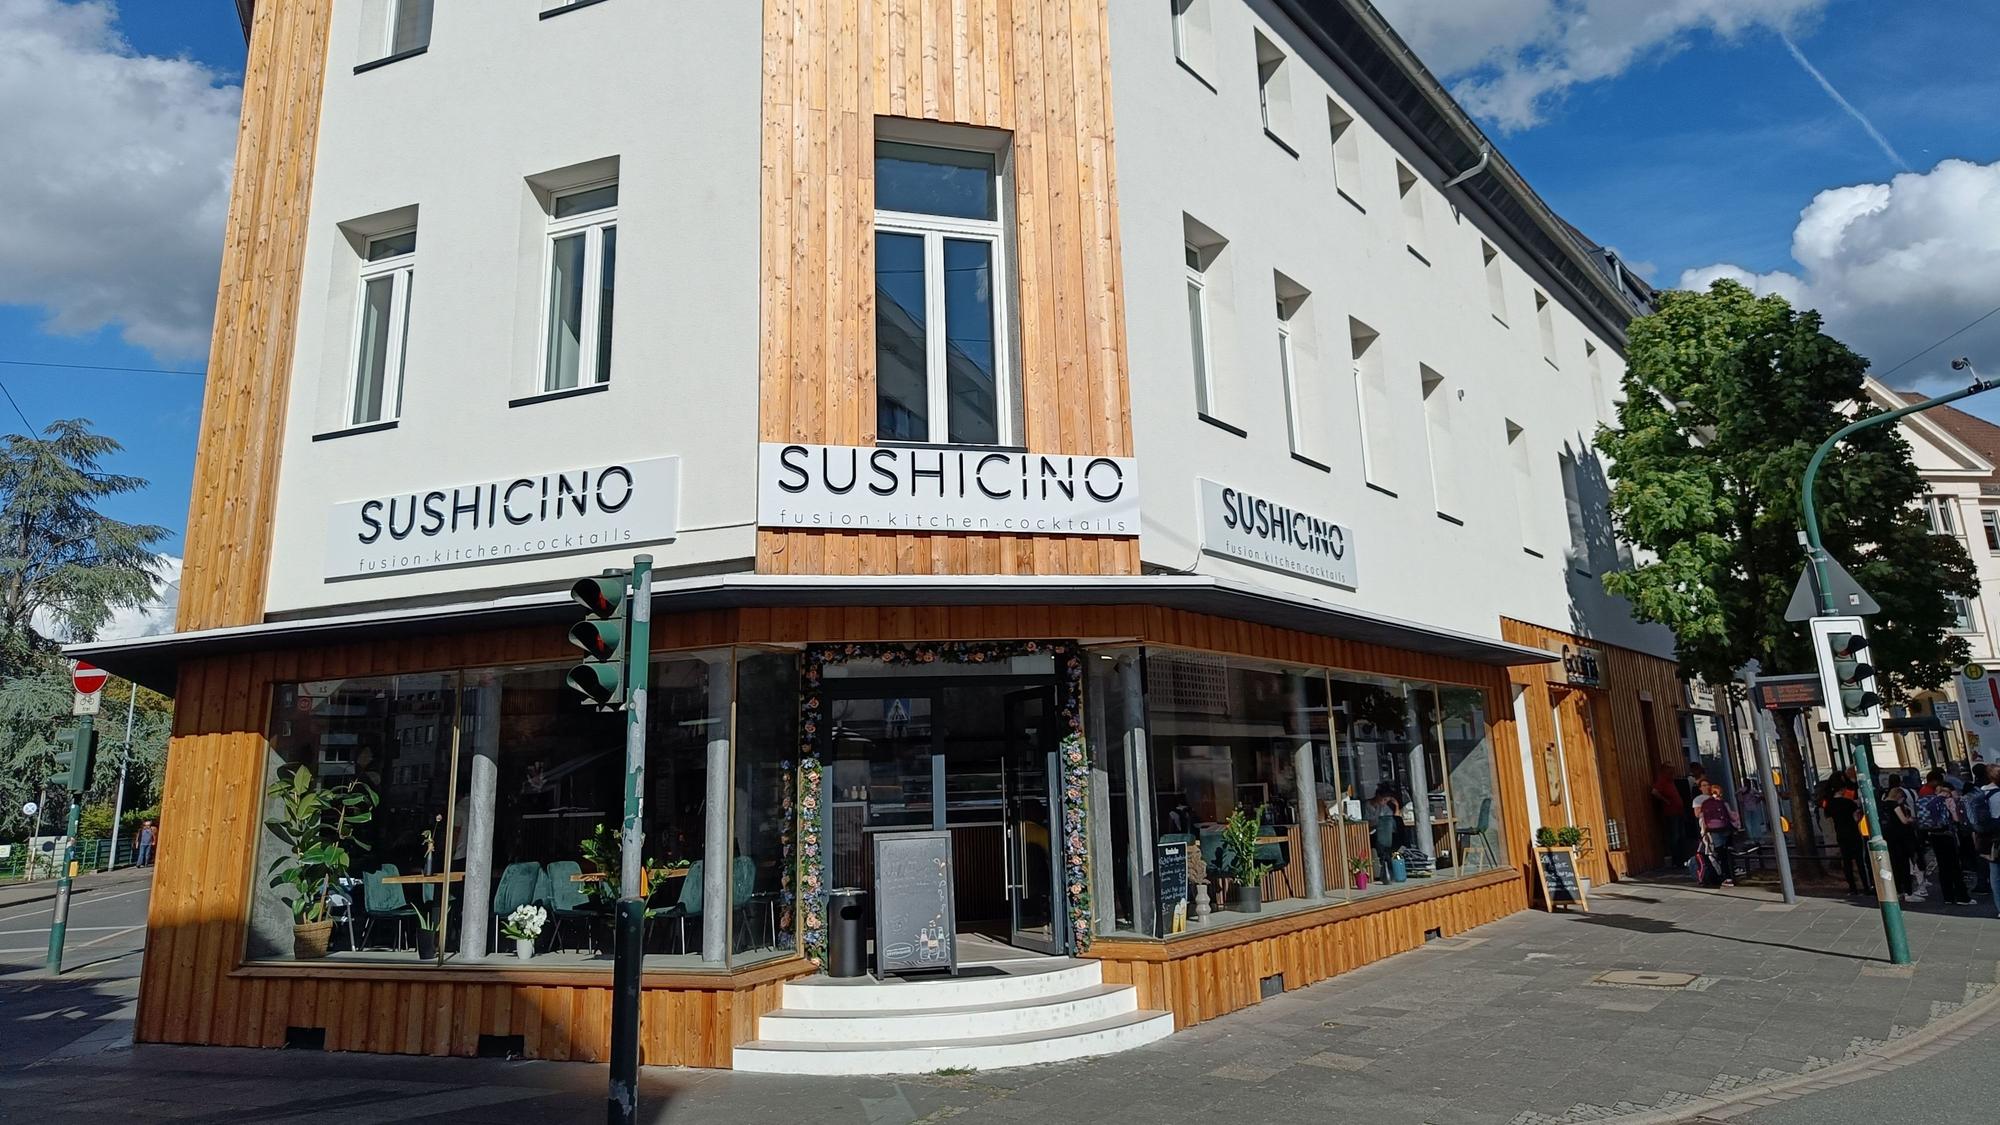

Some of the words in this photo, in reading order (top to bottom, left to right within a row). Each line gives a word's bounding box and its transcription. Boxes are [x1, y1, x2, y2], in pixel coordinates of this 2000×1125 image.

[358, 465, 633, 545] SUSHICINO
[777, 444, 1124, 503] SUSHICINO
[1222, 487, 1344, 561] SUSHICINO
